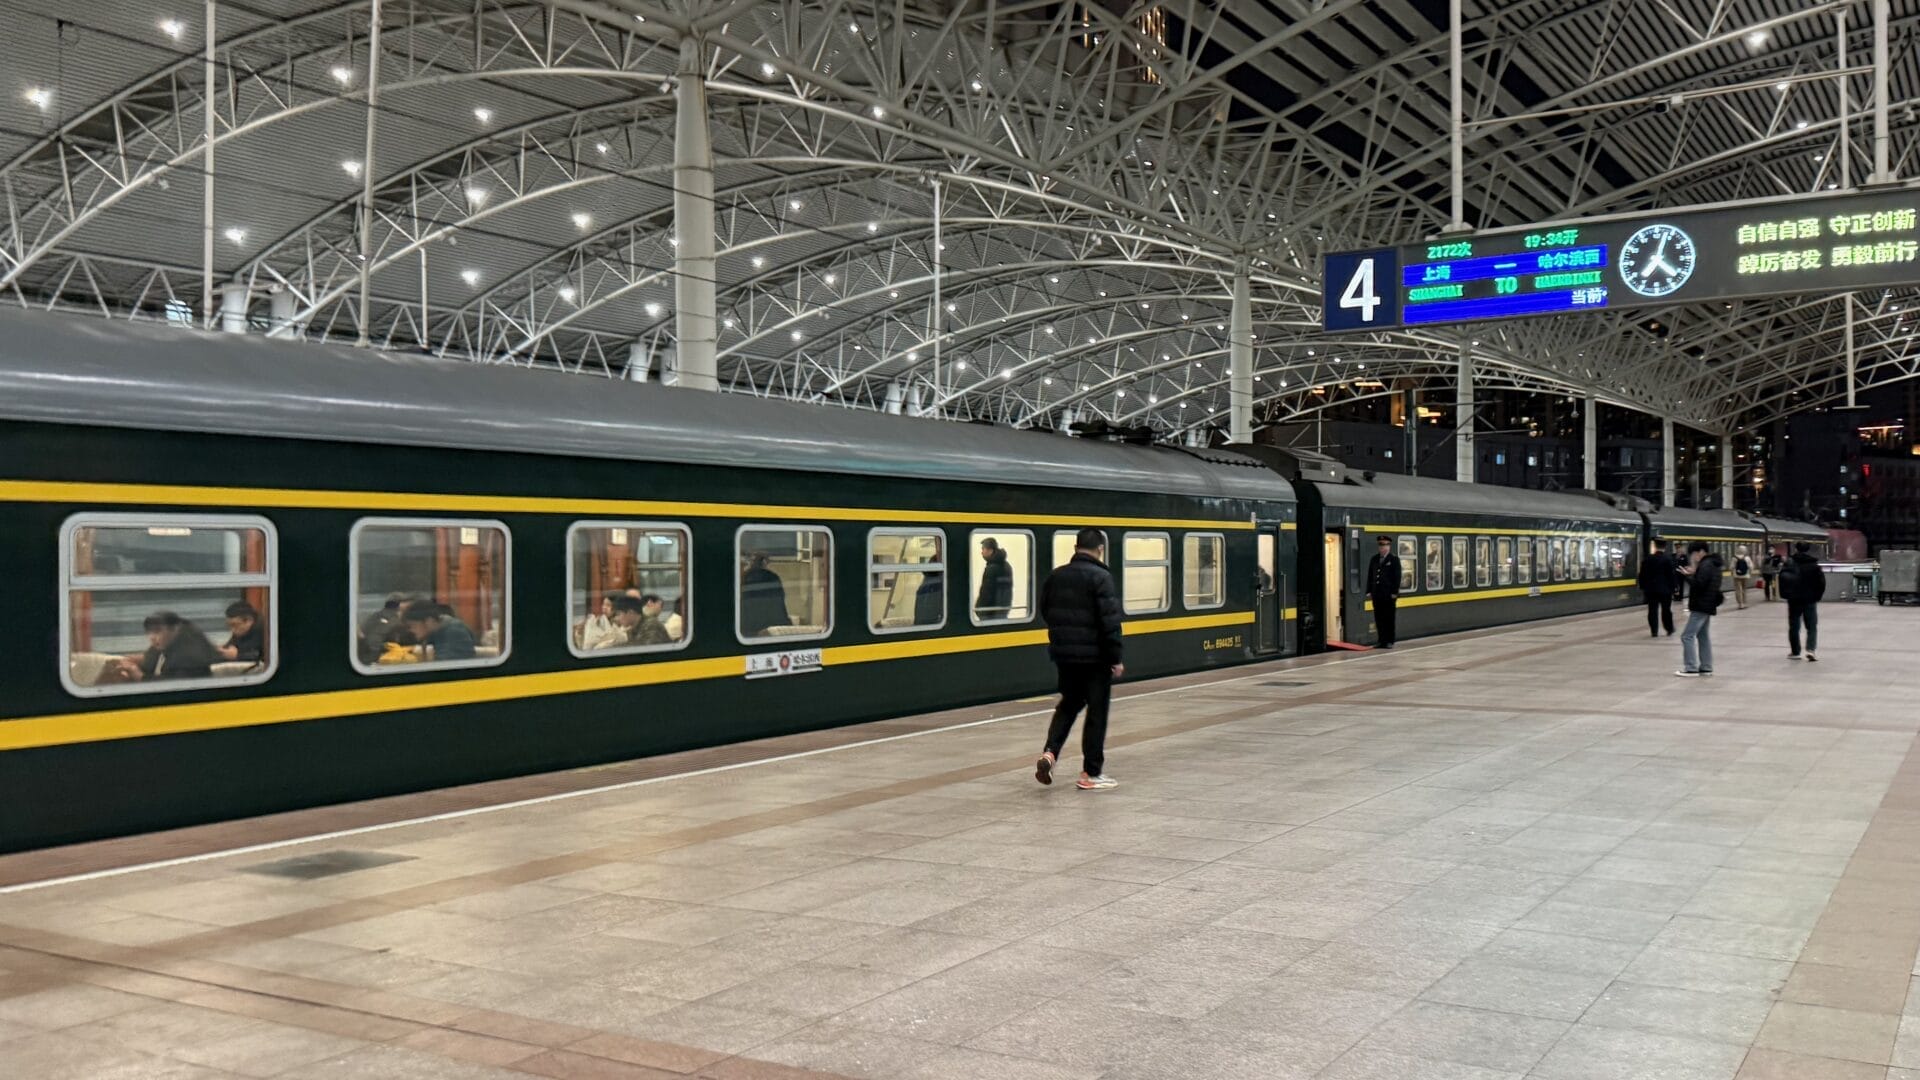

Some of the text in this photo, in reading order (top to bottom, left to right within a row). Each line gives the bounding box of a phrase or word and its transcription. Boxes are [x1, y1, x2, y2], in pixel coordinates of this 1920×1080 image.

[1524, 229, 1579, 248] 19:34开
[1738, 208, 1916, 244] 自信自强 守正创新
[1422, 265, 1451, 281] 上海
[1537, 249, 1600, 269] 哈尔滨西
[1737, 240, 1918, 274] 踔厉奋发 勇毅前行
[1340, 258, 1381, 321] 4
[1494, 276, 1518, 294] TO
[1571, 287, 1608, 304] 当前
